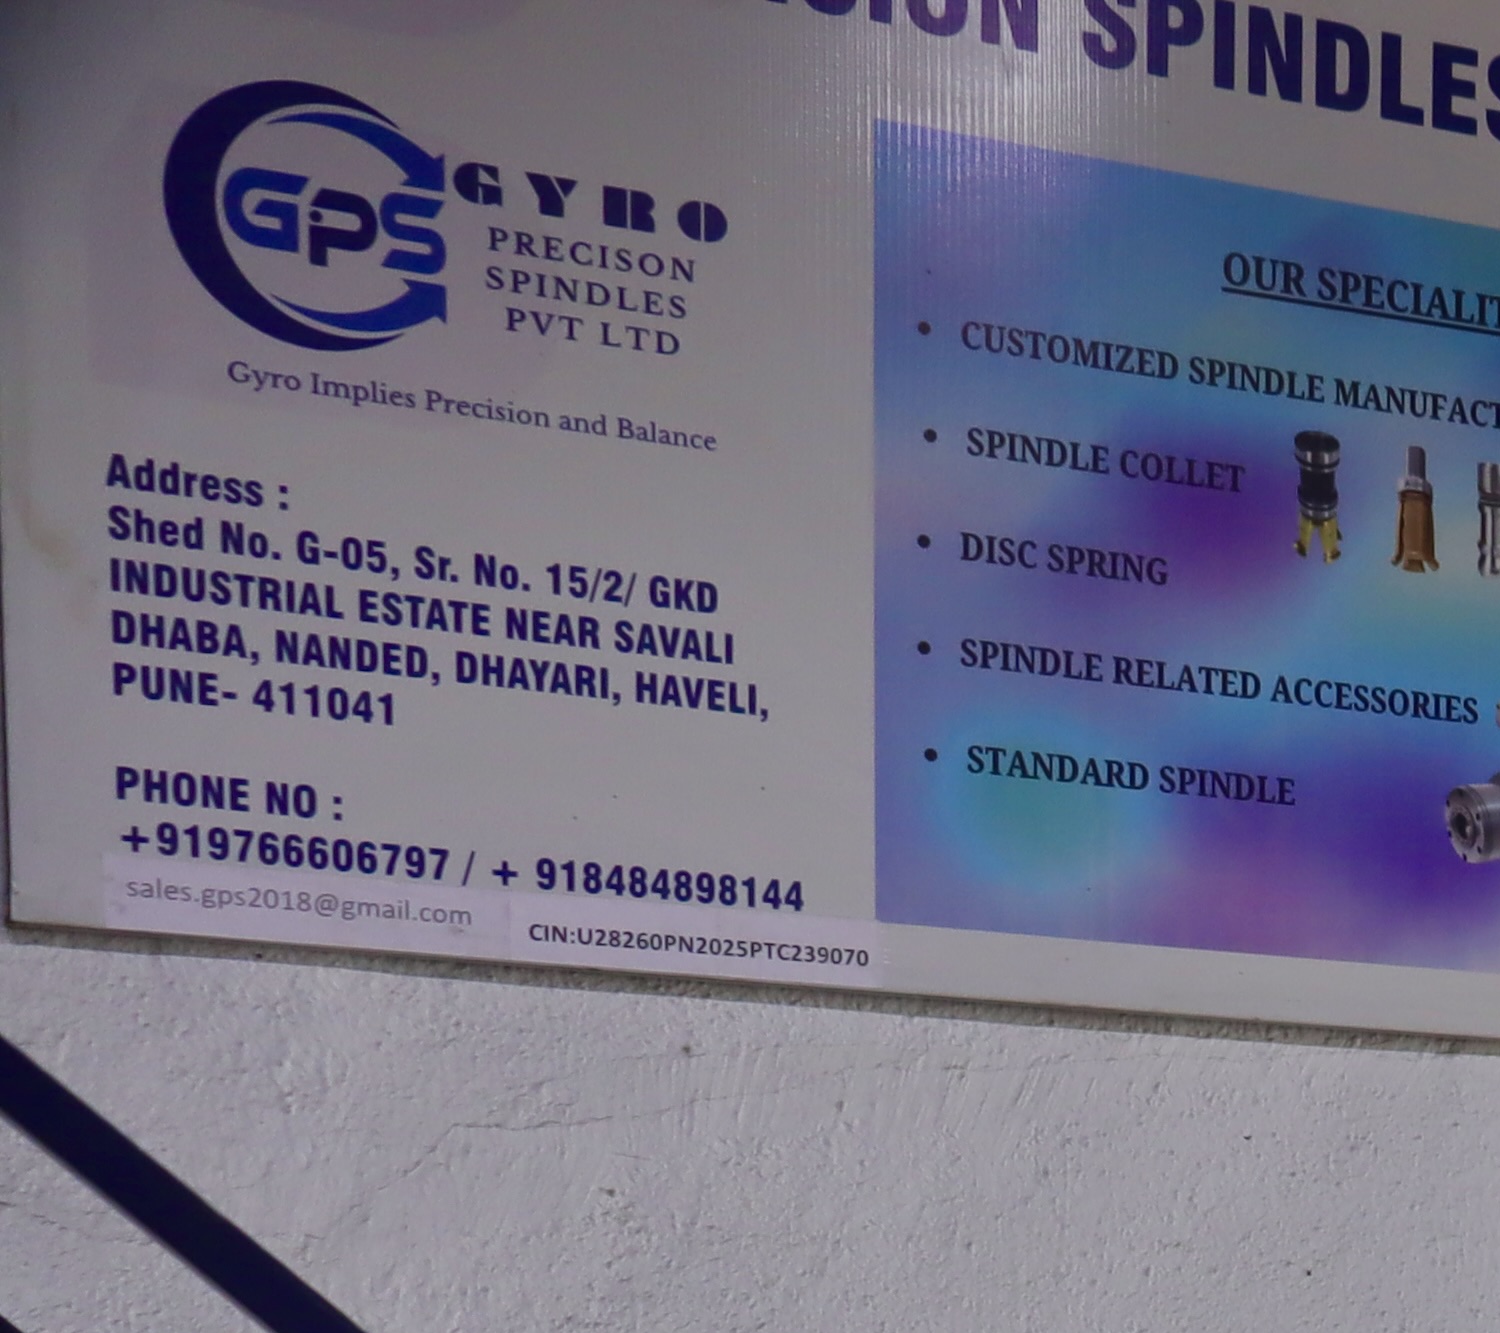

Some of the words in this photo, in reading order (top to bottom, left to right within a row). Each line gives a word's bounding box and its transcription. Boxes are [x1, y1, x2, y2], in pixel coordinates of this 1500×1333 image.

[453, 162, 728, 243] GYRO
[486, 227, 694, 284] PRECISON
[1224, 253, 1306, 297] OUR
[486, 266, 686, 318] SPINDLES
[506, 307, 583, 341] PVT
[601, 322, 680, 355] LTD
[962, 322, 1178, 379] CUSTOMIZED
[1189, 357, 1324, 403] SPINDLE
[228, 361, 301, 391] Gyro
[312, 373, 415, 408] Implies
[426, 390, 549, 427] Precision
[559, 408, 607, 436] and
[618, 418, 716, 450] Balance
[106, 453, 264, 507] Address
[967, 428, 1109, 474] SPINDLE
[1120, 450, 1245, 491] COLLET
[108, 505, 204, 550] Shed
[220, 520, 281, 560] No.
[296, 530, 400, 581] G-05,
[414, 546, 459, 583] Sr.
[474, 553, 530, 592] No.
[546, 563, 637, 607] 15/2/
[649, 575, 718, 614] GKD
[961, 532, 1036, 568] DISC
[1048, 544, 1167, 585] SPRING
[110, 558, 344, 619] INDUSTRIAL
[358, 589, 491, 637] ESTATE
[505, 607, 600, 650] NEAR
[614, 620, 733, 665] SAVALI
[111, 609, 260, 666] DHABA,
[275, 629, 440, 686] NANDED,
[455, 650, 621, 706] DHAYARI,
[635, 671, 768, 722] HAVELI,
[112, 662, 237, 707] PUNE-
[252, 679, 393, 726] 411041
[961, 639, 1103, 682] SPINDLE
[1113, 656, 1261, 699] RELATED
[1270, 676, 1478, 724] ACCESSORIES
[116, 766, 250, 812] PHONE
[265, 781, 317, 819] NO
[967, 745, 1149, 790] STANDARD
[1159, 765, 1294, 805] SPINDLE
[120, 822, 449, 880] +919766606797
[536, 858, 804, 912] 918484898144
[128, 879, 471, 924] sales.gps2018@gmail.com
[529, 924, 869, 967] CIN:U28260PN2025PTC239070
